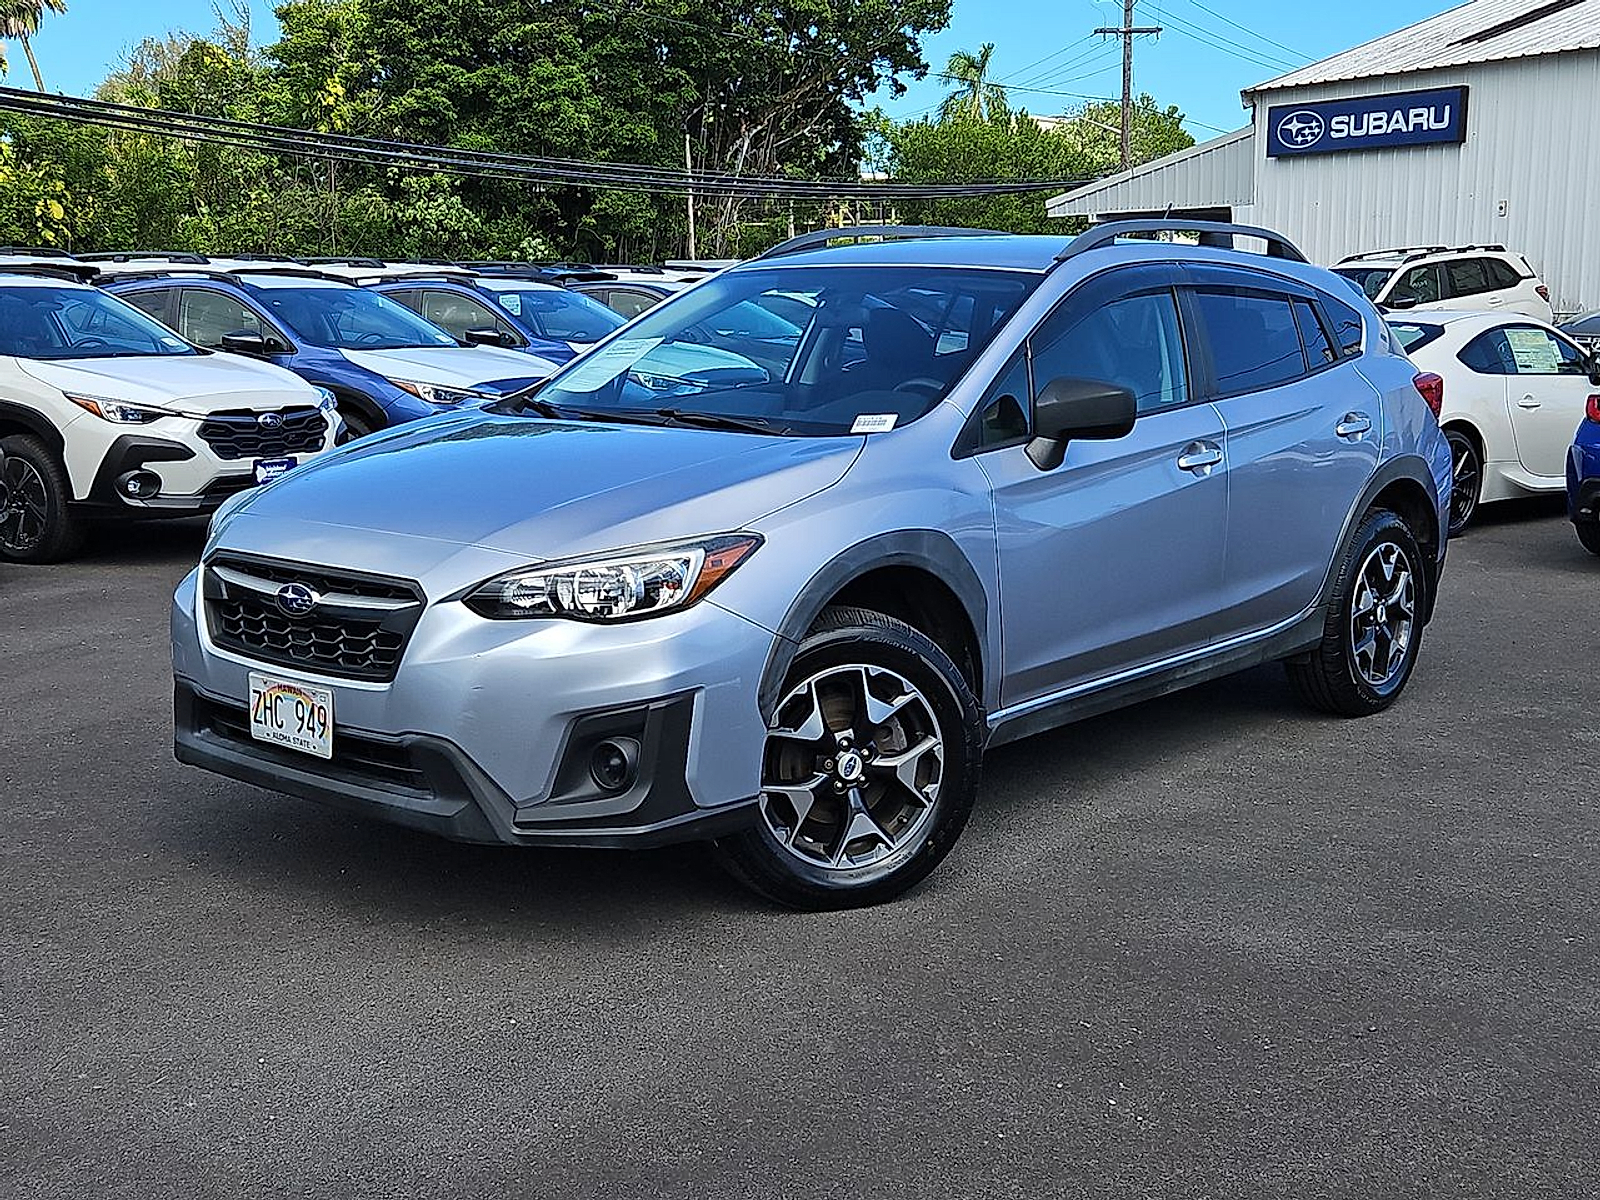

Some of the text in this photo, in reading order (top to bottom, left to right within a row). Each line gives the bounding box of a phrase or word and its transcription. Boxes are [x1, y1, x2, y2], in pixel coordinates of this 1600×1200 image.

[1330, 105, 1450, 139] SUBARU
[252, 689, 327, 739] ZHC 949
[272, 731, 310, 749] ALOHA STATE
